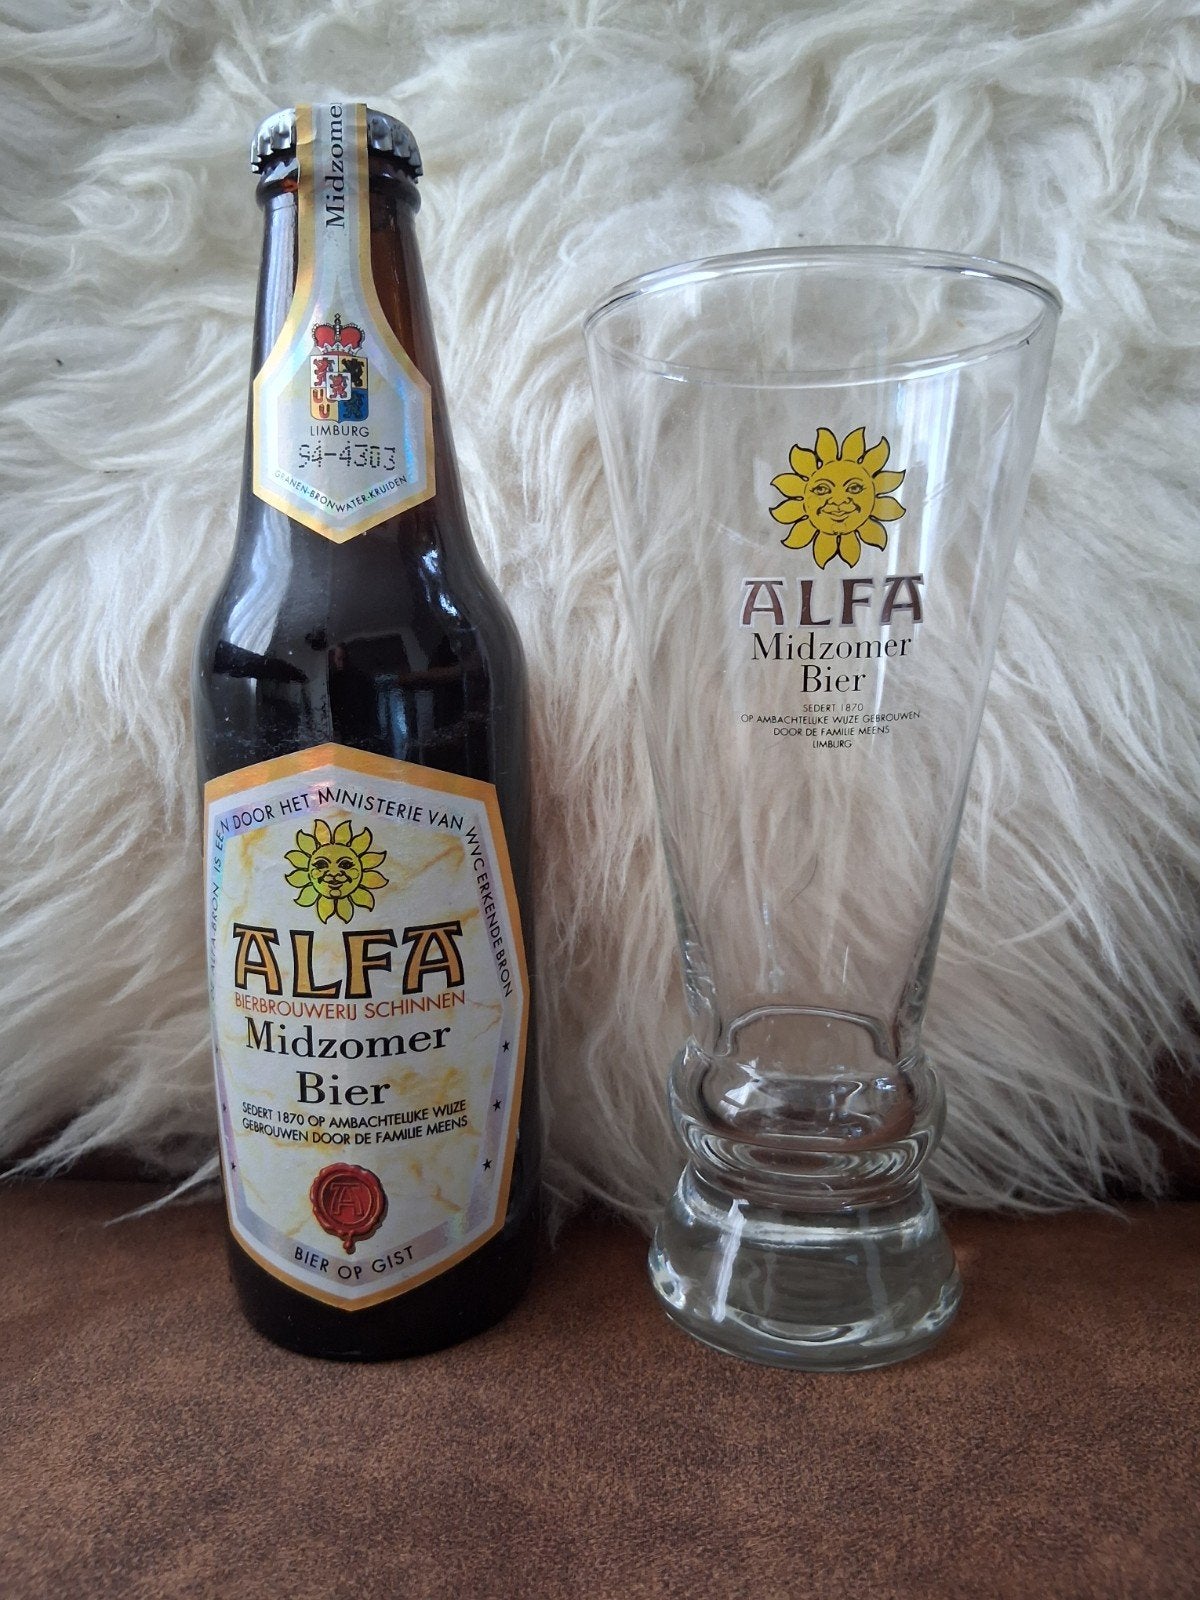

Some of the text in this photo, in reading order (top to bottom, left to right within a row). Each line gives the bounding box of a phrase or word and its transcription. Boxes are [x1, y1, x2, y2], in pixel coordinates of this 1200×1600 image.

[325, 103, 345, 229] Midzome
[310, 425, 370, 438] LIMBURG
[739, 573, 924, 628] ALFA
[751, 632, 912, 660] Midzomer
[800, 664, 867, 693] Bier
[740, 711, 921, 725] OP AMBACHTELIJKE WIJZE GEBROUWEN
[802, 703, 864, 712] SEDERT 1870
[773, 726, 890, 737] DOOR DE FAMILIE MEENS
[812, 740, 853, 749] LIMBURG
[232, 805, 275, 830] DOOR
[279, 793, 310, 815] HET
[318, 787, 423, 822] MINISTERIE
[215, 819, 230, 851] EEN
[428, 809, 464, 831] VAN
[465, 826, 485, 872] WVC
[213, 857, 221, 873] IS
[477, 872, 503, 949] ERKENDE
[233, 920, 465, 999] ALFA
[495, 949, 513, 998] BRON
[235, 990, 465, 1021] BIERBROUWERIJ SCHINNEN
[244, 1016, 451, 1060] Midzomer
[296, 1071, 391, 1106] Bier
[242, 1100, 466, 1129] SEDERT 1870 OP AMBACHTELIJKE WIJZE
[242, 1115, 468, 1145] GEBROUWEN DOOR DE FAMILIE MEENS
[294, 1246, 414, 1280] BIER OP GIST
